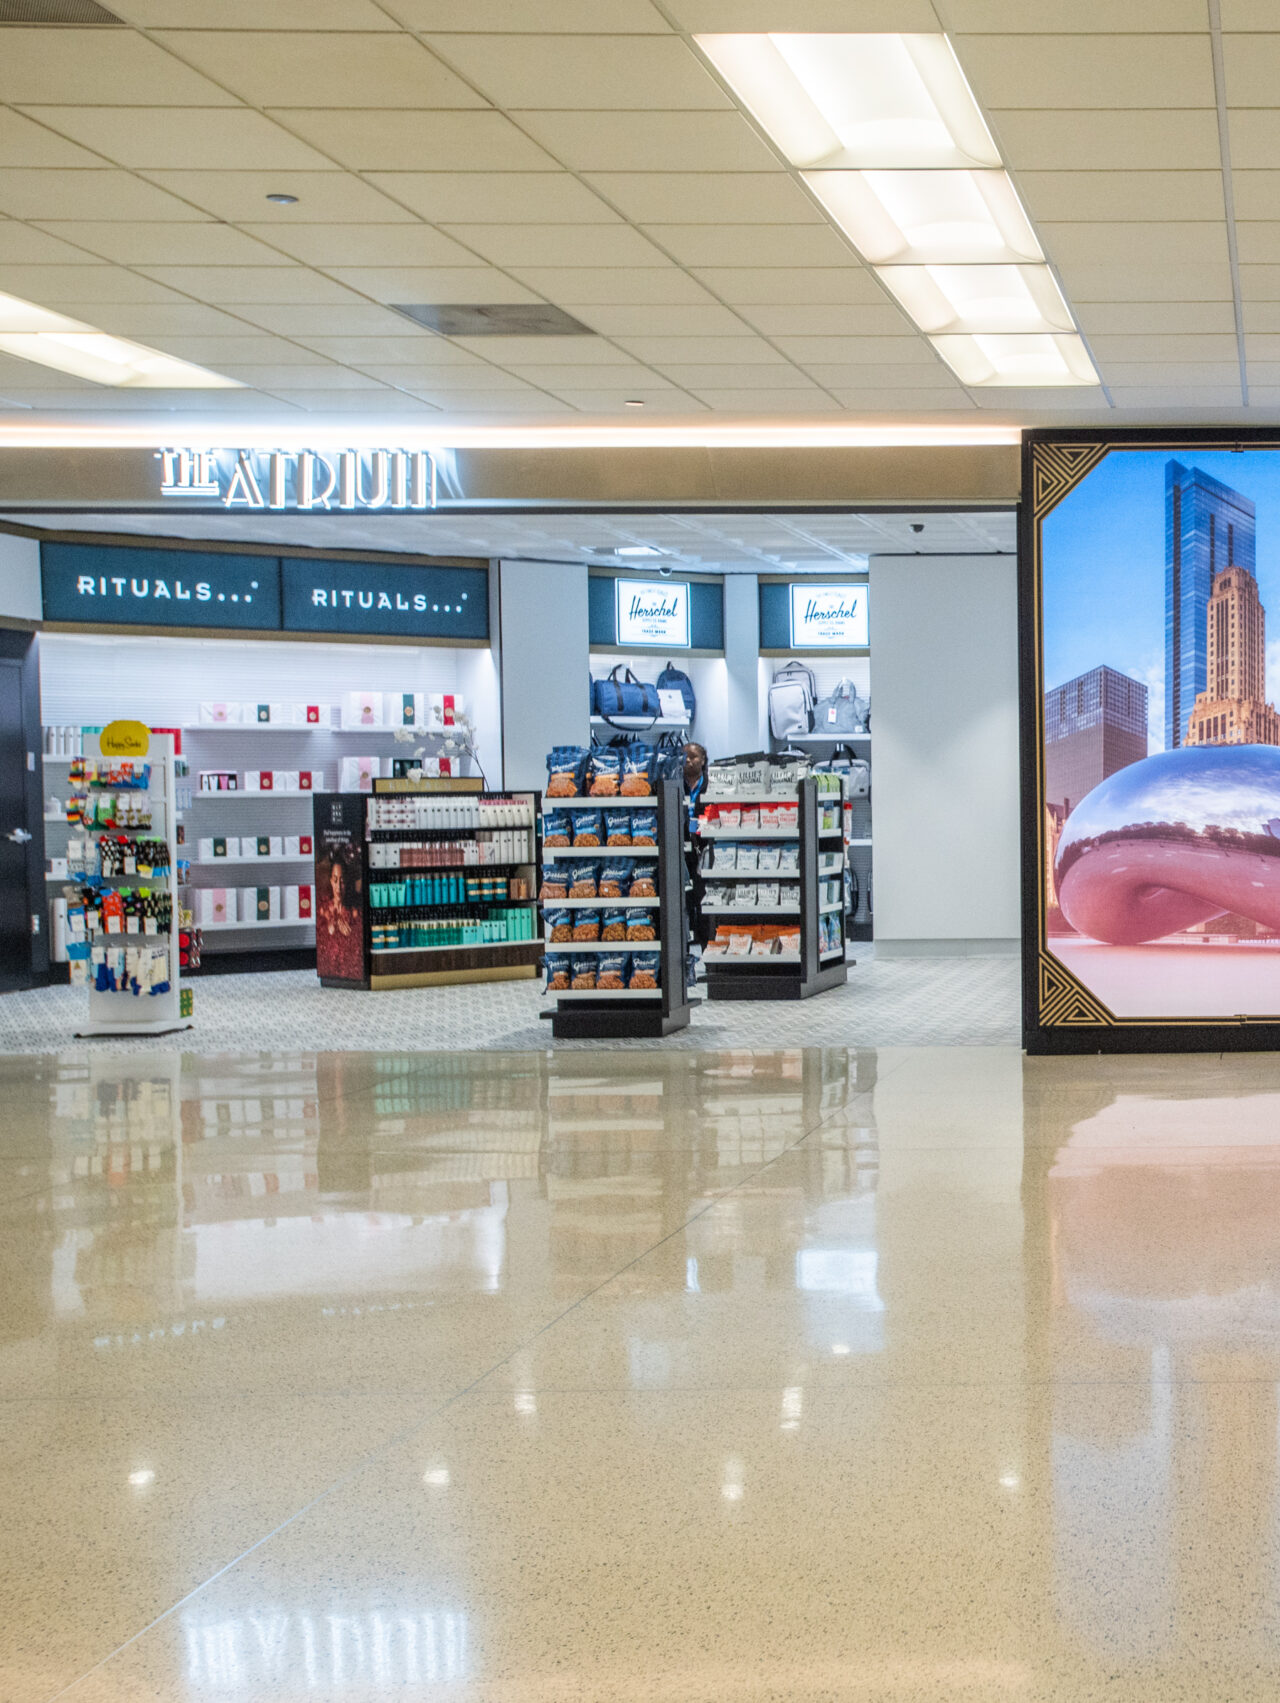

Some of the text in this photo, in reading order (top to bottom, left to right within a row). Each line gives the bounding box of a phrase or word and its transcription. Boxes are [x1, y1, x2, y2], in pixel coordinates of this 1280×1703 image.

[153, 447, 437, 509] THE ATRIUM
[629, 595, 678, 621] Herschel
[804, 599, 857, 624] Herschel
